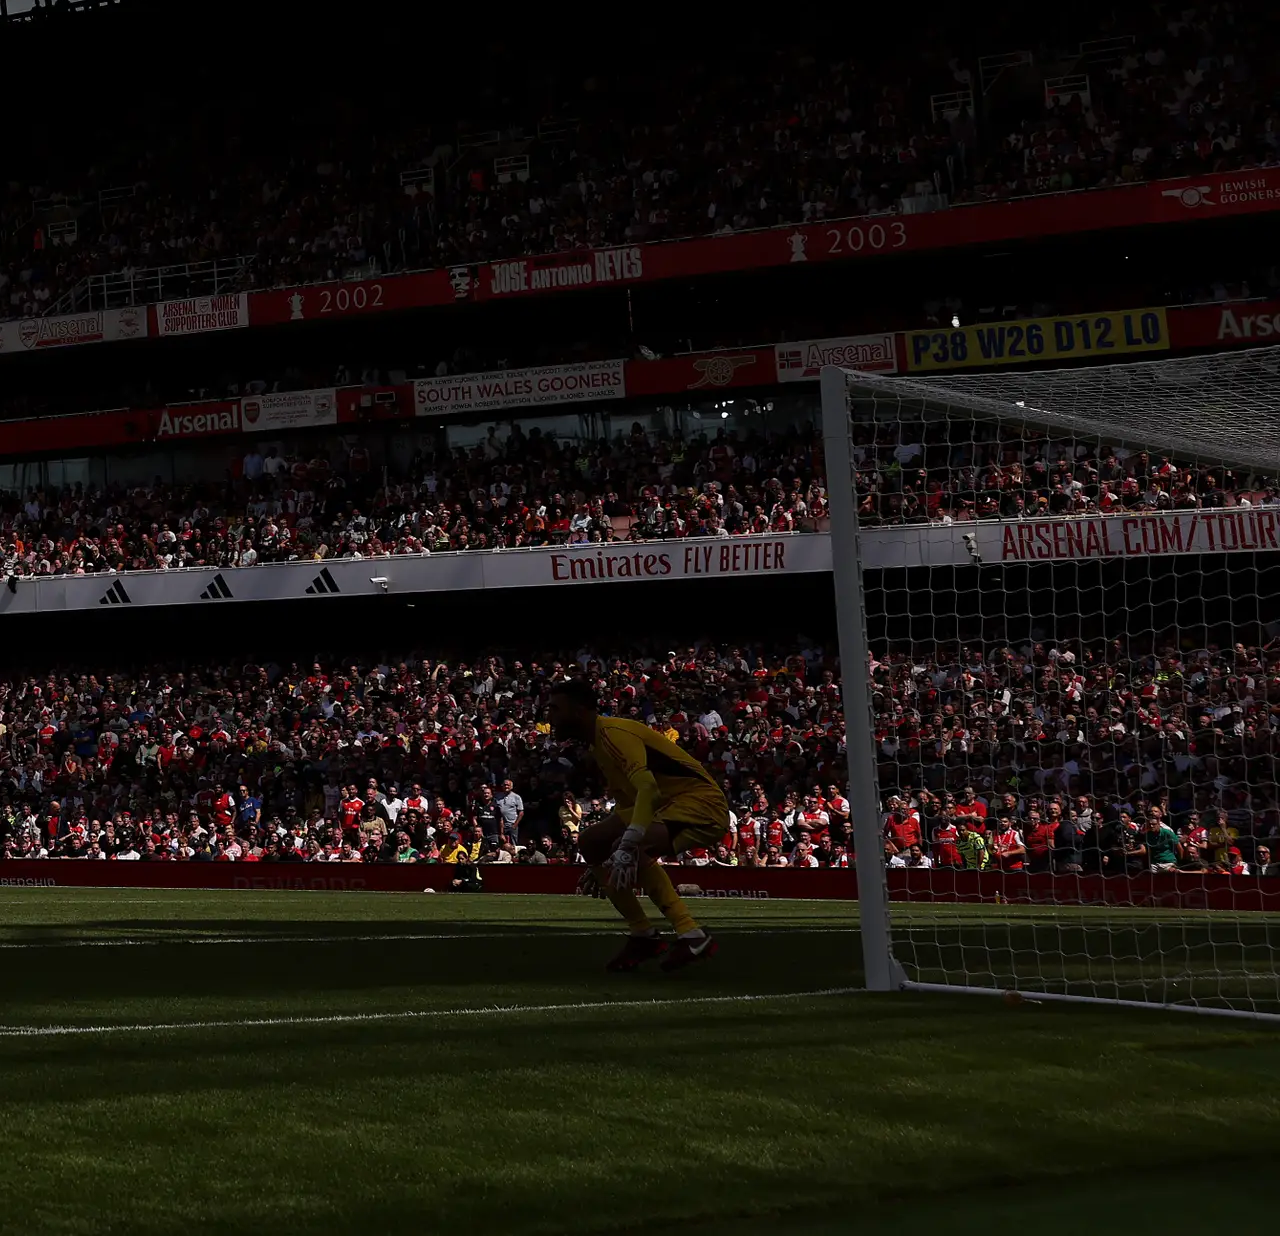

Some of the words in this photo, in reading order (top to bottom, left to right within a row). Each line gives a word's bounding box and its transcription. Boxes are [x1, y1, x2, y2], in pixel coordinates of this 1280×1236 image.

[1220, 178, 1267, 192] JEWISH
[825, 221, 908, 255] 2003
[491, 261, 528, 294] JOSE
[530, 263, 593, 290] ANTONIO
[594, 247, 643, 283] REYES
[162, 301, 197, 318] ARSENAL
[210, 294, 240, 311] WOMEN
[319, 284, 384, 313] 2002
[40, 312, 103, 338] Arsenal
[164, 314, 217, 332] SUPPORTERS
[217, 311, 238, 326] CLUB
[807, 337, 894, 368] Arsenal
[912, 331, 968, 366] P38
[977, 324, 1044, 359] W26
[1054, 317, 1114, 353] D12
[418, 386, 472, 404] SOUTH
[477, 379, 533, 399] WALES
[538, 372, 622, 393] GOONERS
[157, 404, 239, 436] Arsenal
[551, 551, 672, 581] Emirates
[684, 545, 713, 574] FLY
[719, 542, 786, 573] BETTER
